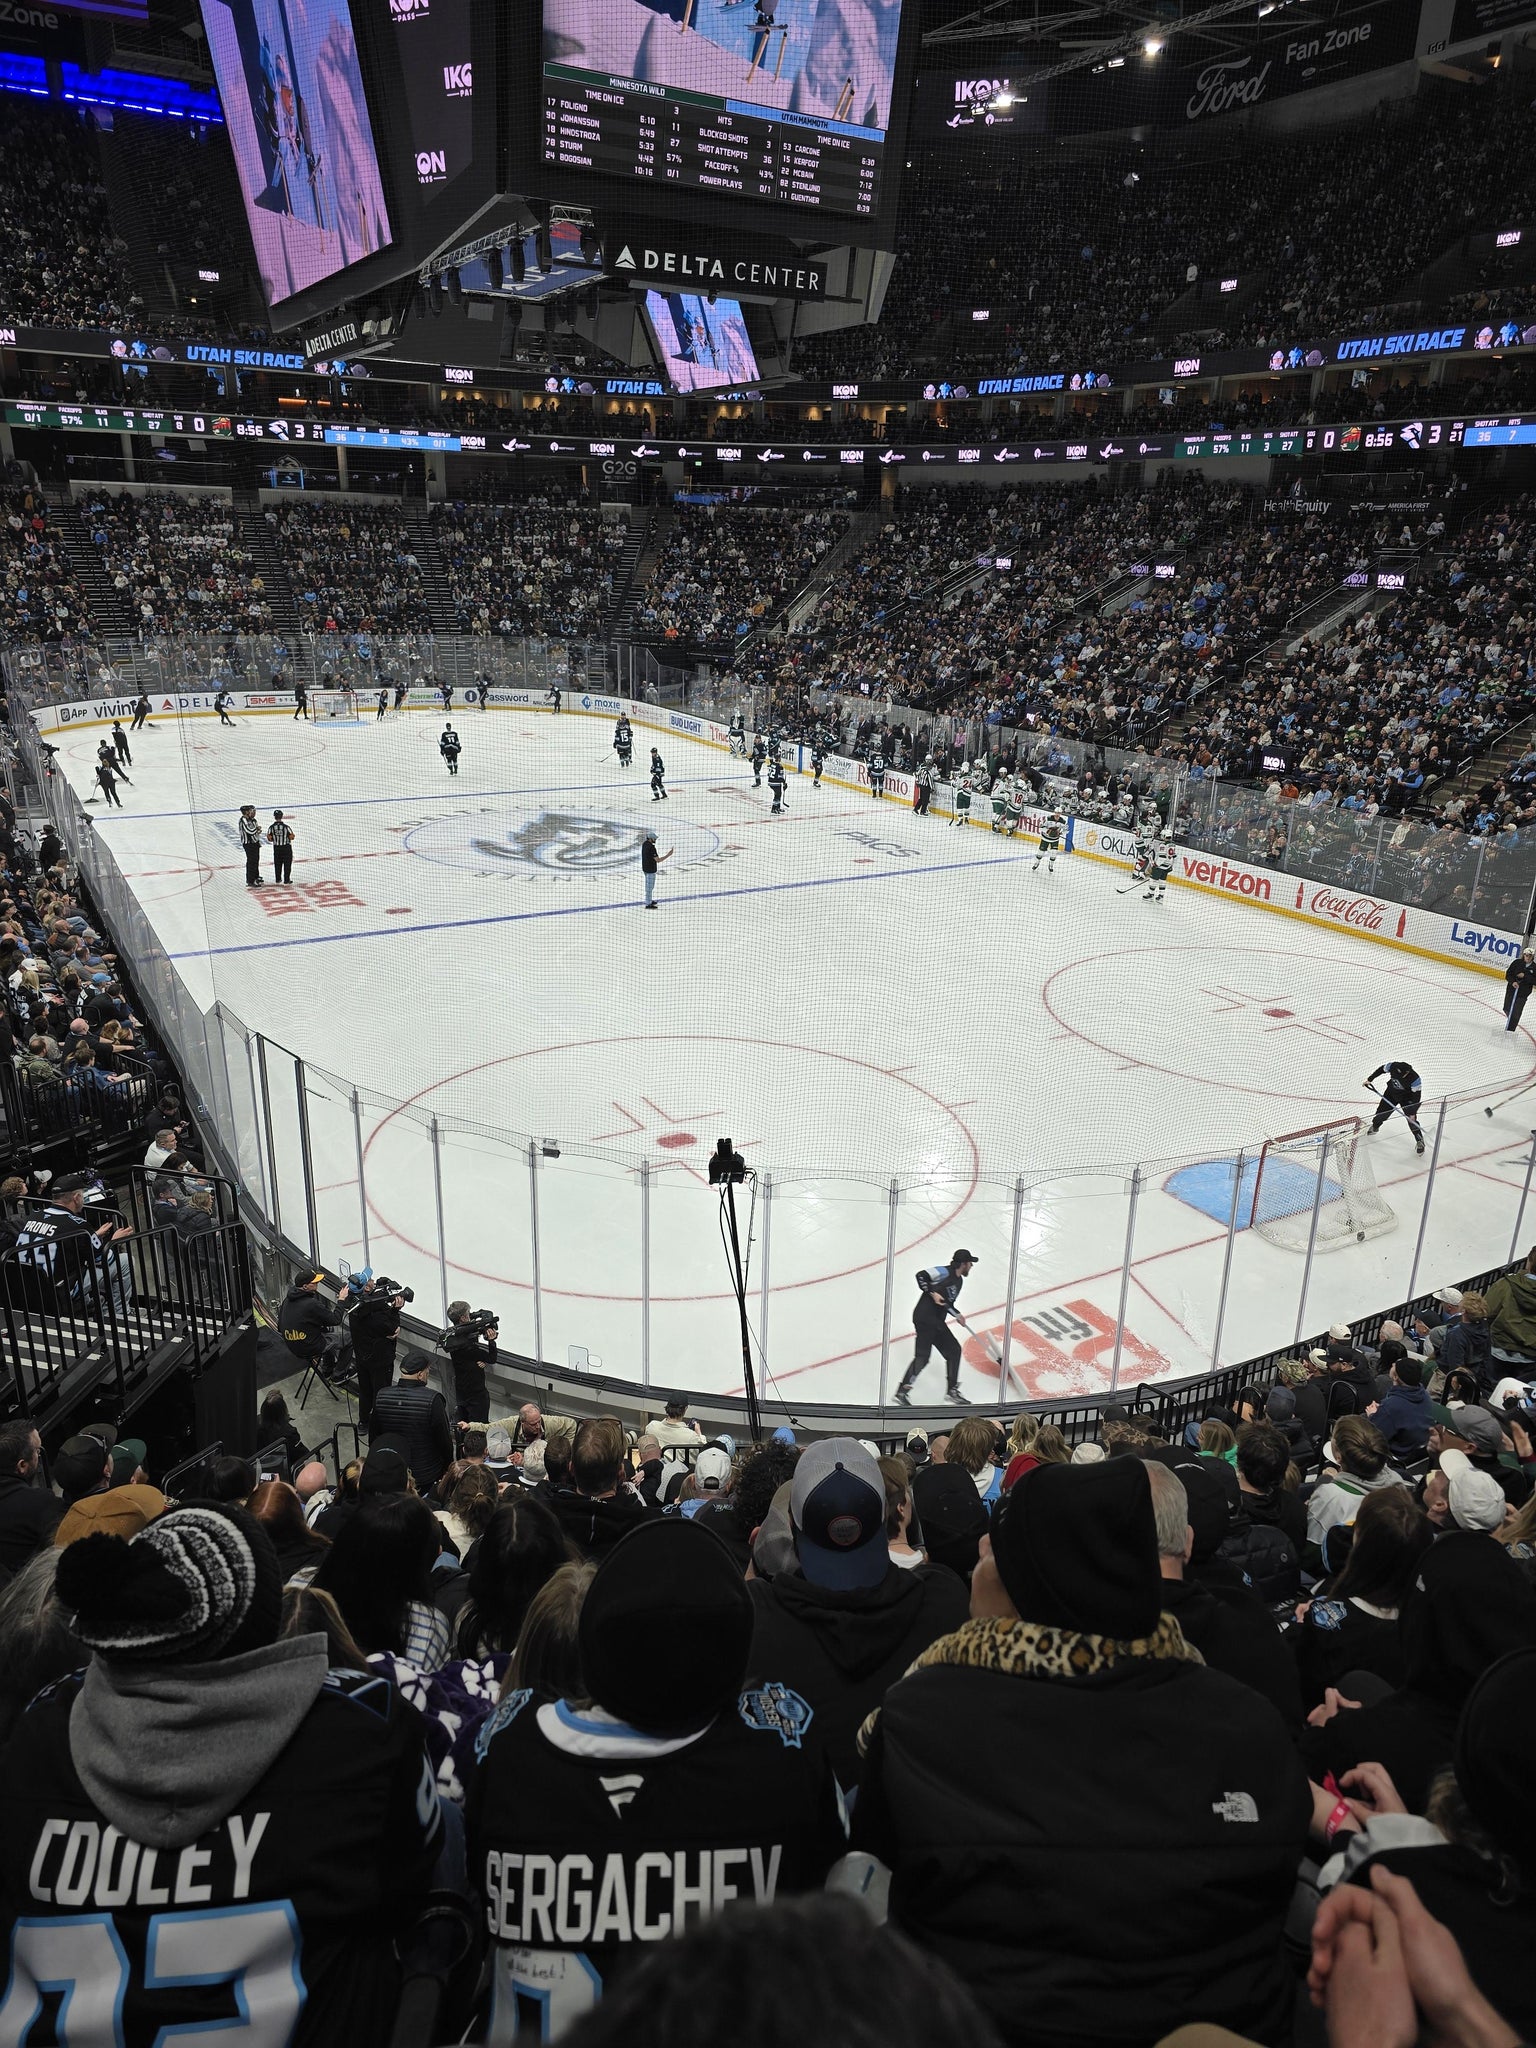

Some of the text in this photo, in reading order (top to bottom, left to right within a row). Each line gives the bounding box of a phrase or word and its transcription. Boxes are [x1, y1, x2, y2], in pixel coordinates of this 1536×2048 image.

[0, 2, 58, 30] Zone
[1286, 24, 1372, 64] Fan Zone
[610, 78, 666, 96] MINNESOTA WILD
[1186, 56, 1272, 120] Ford
[585, 90, 625, 105] TIME ON ICE
[547, 98, 656, 126] 17 FOLIGNO 6:10
[546, 111, 656, 138] 90 JOHANSSON 6:49
[718, 116, 733, 126] HITS
[782, 113, 829, 129] UTAH MAMMOTH
[546, 124, 654, 151] 18 HINOSTROZA 5:33
[672, 122, 680, 132] 11
[699, 127, 728, 141] BLOCKED
[728, 134, 749, 145] SHOTS
[818, 135, 832, 146] TIME
[840, 140, 850, 149] ICE
[546, 138, 654, 164] 78 STURM 4:42
[670, 138, 772, 164] 27 SHOT ATTEMPTS 36
[782, 154, 791, 163] 15
[783, 142, 792, 151] 53
[862, 157, 876, 167] 6:30
[545, 150, 654, 177] 24 BOGOSIAN 10:16
[666, 152, 682, 164] 57%
[704, 160, 732, 172] FACEOFF
[758, 170, 774, 180] 43%
[666, 168, 771, 194] 0/1 POWER PLAYS 0/1
[780, 167, 790, 175] 22
[859, 180, 873, 190] 7:12
[780, 179, 788, 187] 82
[858, 192, 872, 202] 7:00
[780, 191, 788, 199] 11
[1496, 231, 1522, 245] IKON
[644, 250, 819, 291] DELTA CENTER
[310, 323, 358, 356] DELTA CENTER
[1336, 328, 1466, 361] UTAH SKI RACE
[186, 346, 304, 370] UTAH SKI RACE
[1174, 358, 1200, 374] IKON
[445, 368, 474, 380] IKON
[606, 380, 644, 394] UTAH
[832, 385, 858, 395] IKON
[978, 374, 1064, 394] UTAH SKI RACE
[24, 412, 160, 430] 0/1 57% 11 3 27
[176, 418, 206, 432] 8 0
[236, 423, 264, 438] 8:56
[294, 424, 306, 439] 3
[312, 430, 324, 439] 21
[1428, 425, 1442, 444] 3
[1450, 430, 1516, 442] 21 36 7
[336, 433, 346, 442] 36
[382, 436, 388, 444] 3
[433, 439, 446, 448] 0/1
[460, 436, 486, 447] IKON
[1186, 438, 1313, 455] 0/1 57% 11 3 27 8
[1323, 431, 1335, 448] 0
[1364, 432, 1394, 448] 8:56
[590, 444, 615, 454] IKON
[716, 448, 742, 458] IKON
[840, 450, 864, 460] IKON
[958, 449, 980, 460] IKON
[1066, 446, 1088, 457] IKON
[602, 460, 637, 475] G2G
[1264, 499, 1330, 514] HealthEquity
[1155, 565, 1174, 576] IKON
[1376, 574, 1404, 587] IKON
[594, 698, 621, 710] moxie
[71, 708, 88, 718] App
[671, 715, 702, 732] BUD LIGHT
[620, 732, 630, 742] 15
[874, 759, 884, 770] 50
[884, 774, 908, 796] into
[963, 779, 972, 789] 24
[1014, 794, 1023, 804] 18
[1101, 835, 1137, 859] OKLA
[1183, 856, 1271, 900] verizon
[1311, 888, 1390, 930] Coca-Cola
[1450, 922, 1522, 959] Layton
[23, 1220, 58, 1238] PROWS
[1020, 1306, 1094, 1342] fit
[30, 1812, 271, 1907] COOLEY
[486, 1844, 782, 1942] SERGACHEV
